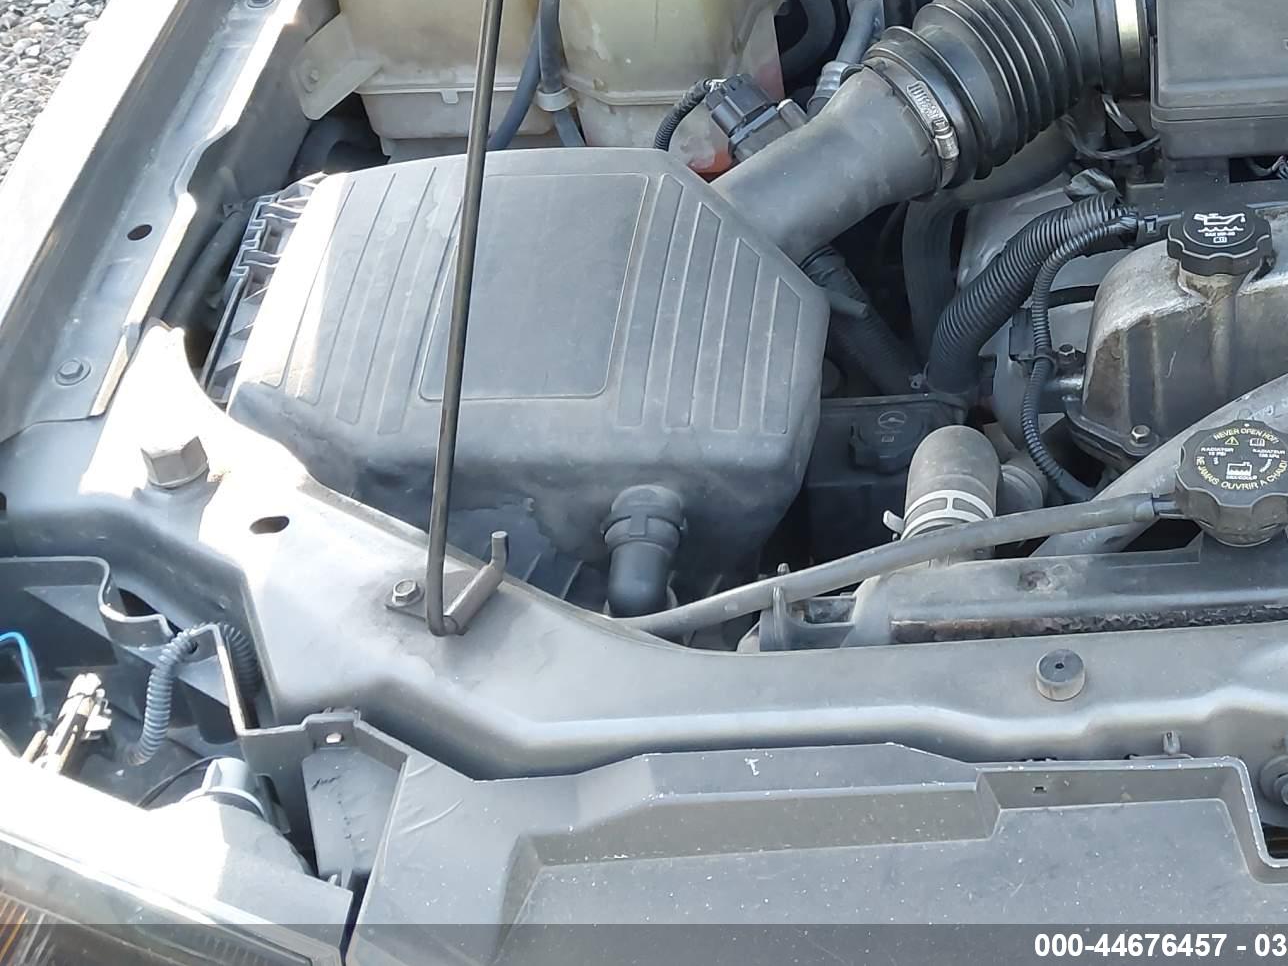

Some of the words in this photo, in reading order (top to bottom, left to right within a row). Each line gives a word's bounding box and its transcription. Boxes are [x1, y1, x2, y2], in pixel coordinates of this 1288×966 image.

[1213, 427, 1241, 441] NEVER
[1240, 427, 1264, 437] OPEN
[1200, 446, 1235, 454] RADIATOR
[1220, 480, 1259, 491] OUVRIR
